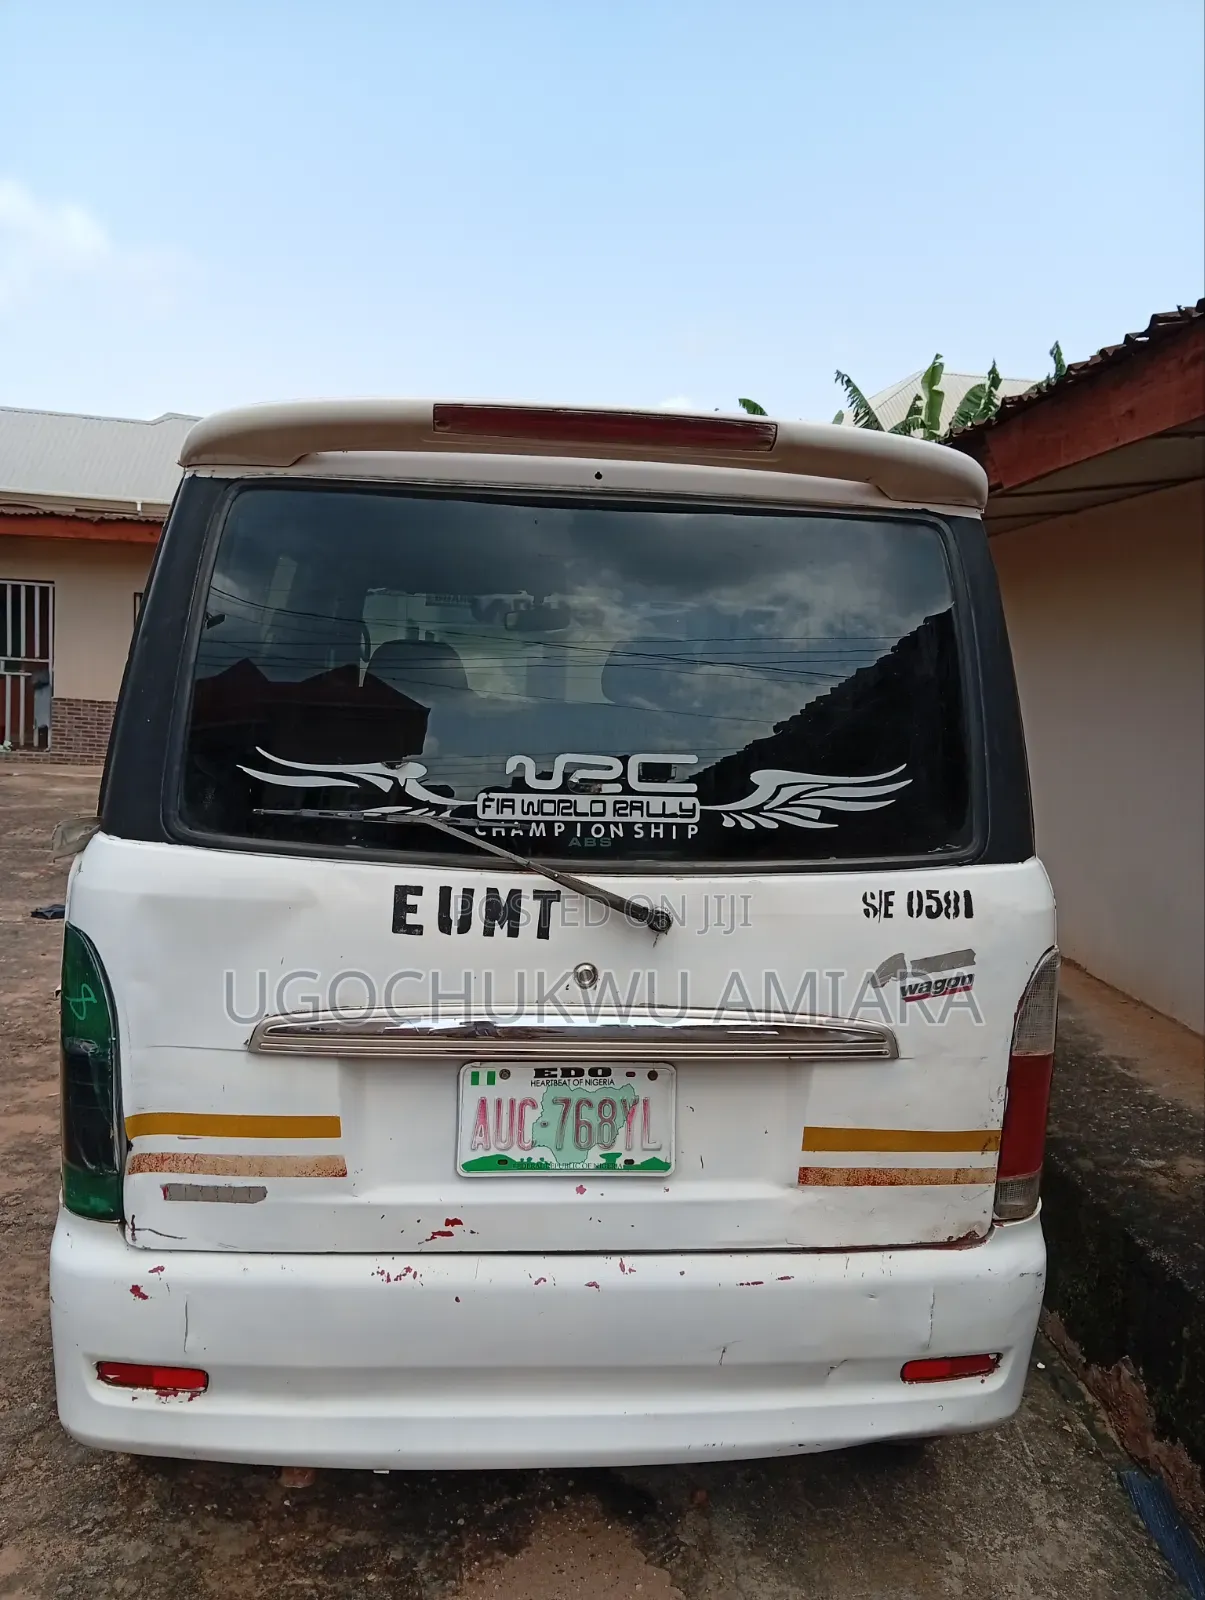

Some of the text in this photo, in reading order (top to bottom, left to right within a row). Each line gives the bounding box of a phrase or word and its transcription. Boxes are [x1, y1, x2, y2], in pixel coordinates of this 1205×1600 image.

[482, 797, 697, 819] FIA WORLD RALLY
[568, 837, 612, 848] ABS
[392, 884, 561, 941] EUMT
[906, 889, 974, 920] 0581
[899, 973, 975, 999] wagon
[530, 1078, 615, 1088] HEARTBEAT OF NIGERIA
[533, 1066, 612, 1079] EDO
